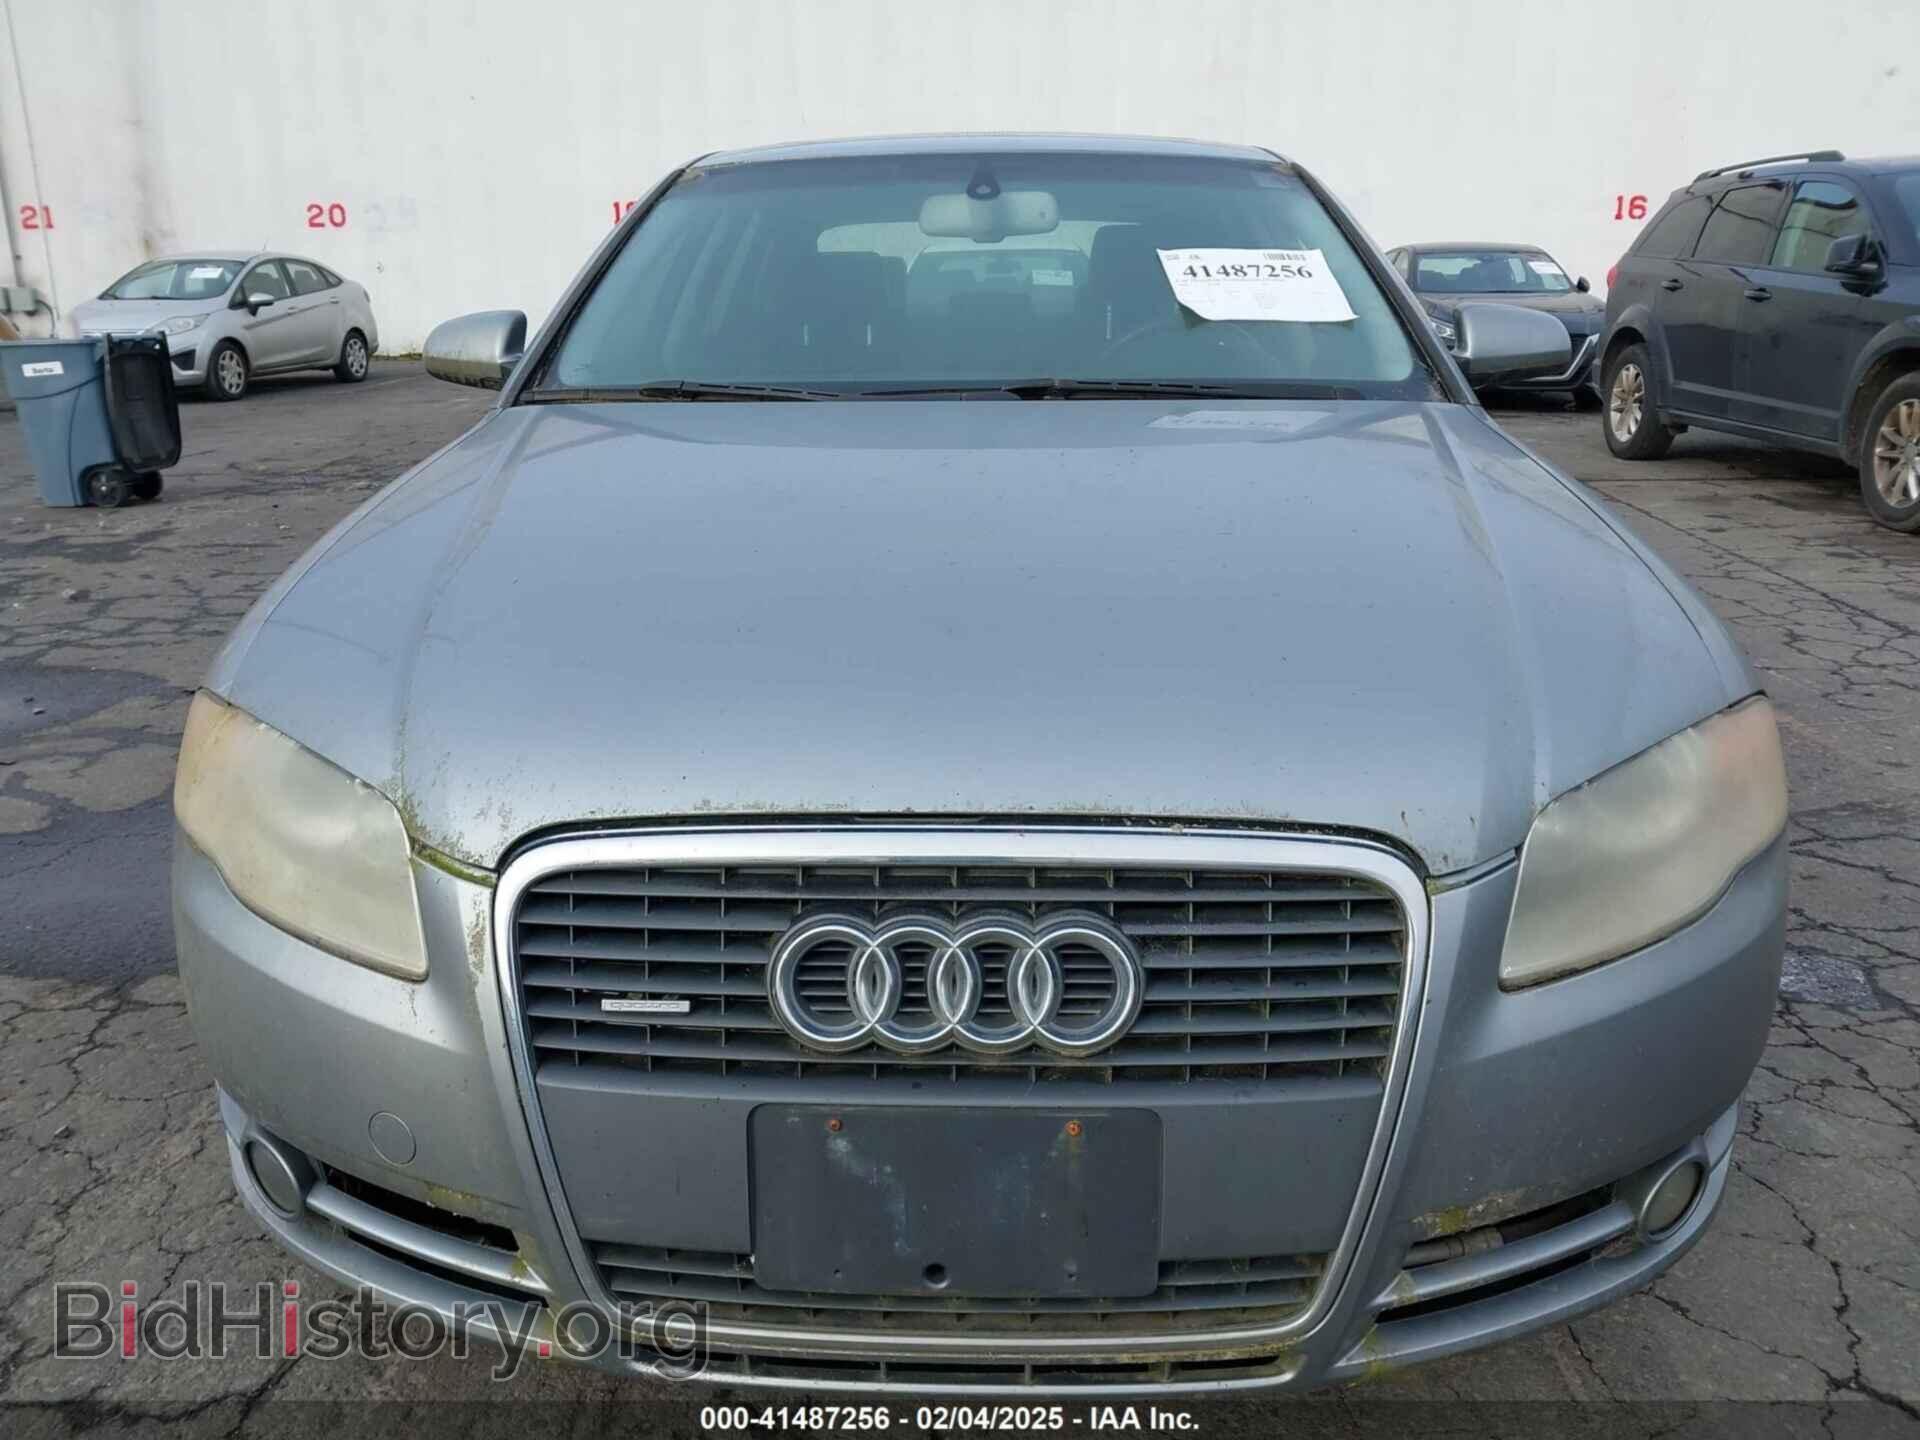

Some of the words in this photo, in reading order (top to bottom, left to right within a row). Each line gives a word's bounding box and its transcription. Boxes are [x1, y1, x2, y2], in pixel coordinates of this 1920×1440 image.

[20, 205, 54, 229] 21
[306, 203, 346, 228] 20
[1614, 195, 1648, 220] 16
[1183, 264, 1313, 278] 41487256
